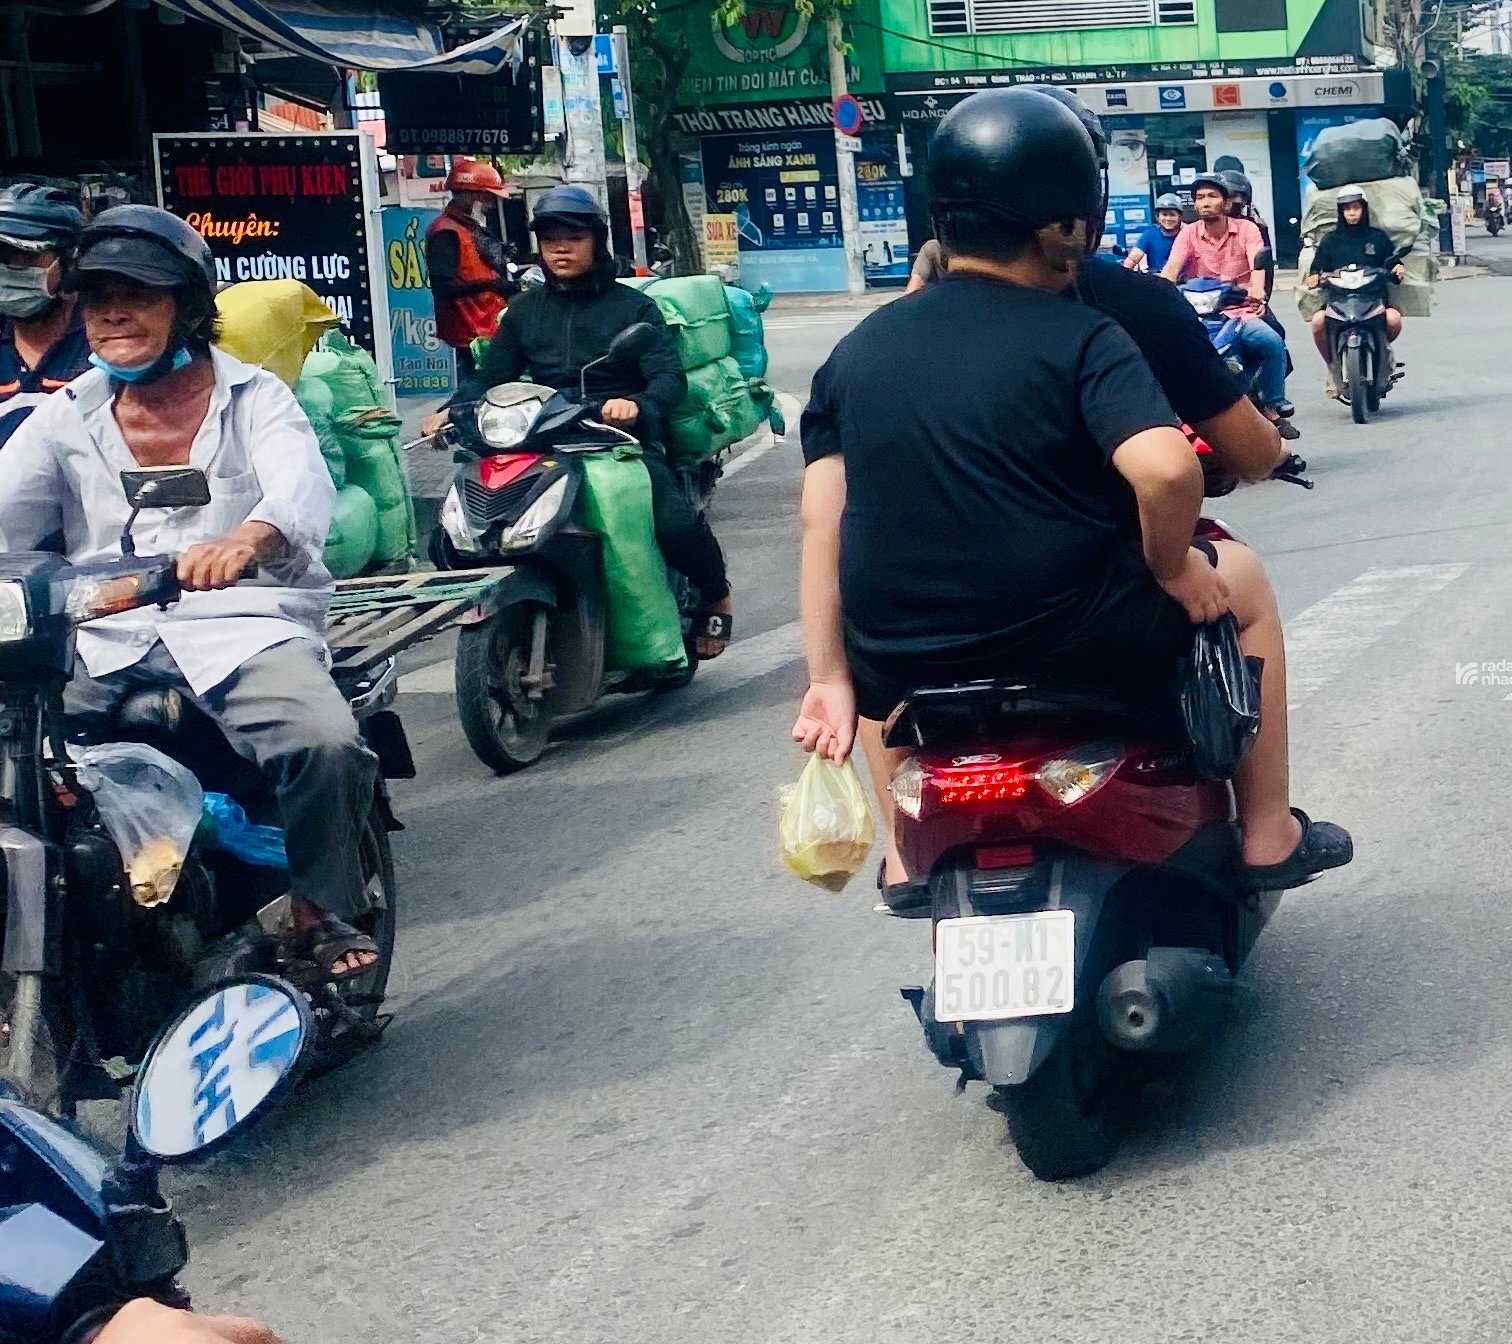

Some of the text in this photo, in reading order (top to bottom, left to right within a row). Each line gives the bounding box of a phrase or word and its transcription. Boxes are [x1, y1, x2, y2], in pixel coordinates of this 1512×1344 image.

[1314, 86, 1353, 96] CHEMI
[719, 106, 785, 132] TRANG
[785, 99, 834, 127] HÀNG
[785, 153, 816, 166] XANH
[174, 152, 212, 197] THẾ
[301, 155, 347, 204] KIỆN
[716, 188, 749, 204] 280K
[185, 210, 280, 244] Chuyên:
[236, 250, 306, 281] CƯỜNG
[312, 252, 350, 288] LỰC
[945, 967, 1064, 1012] 500.82
